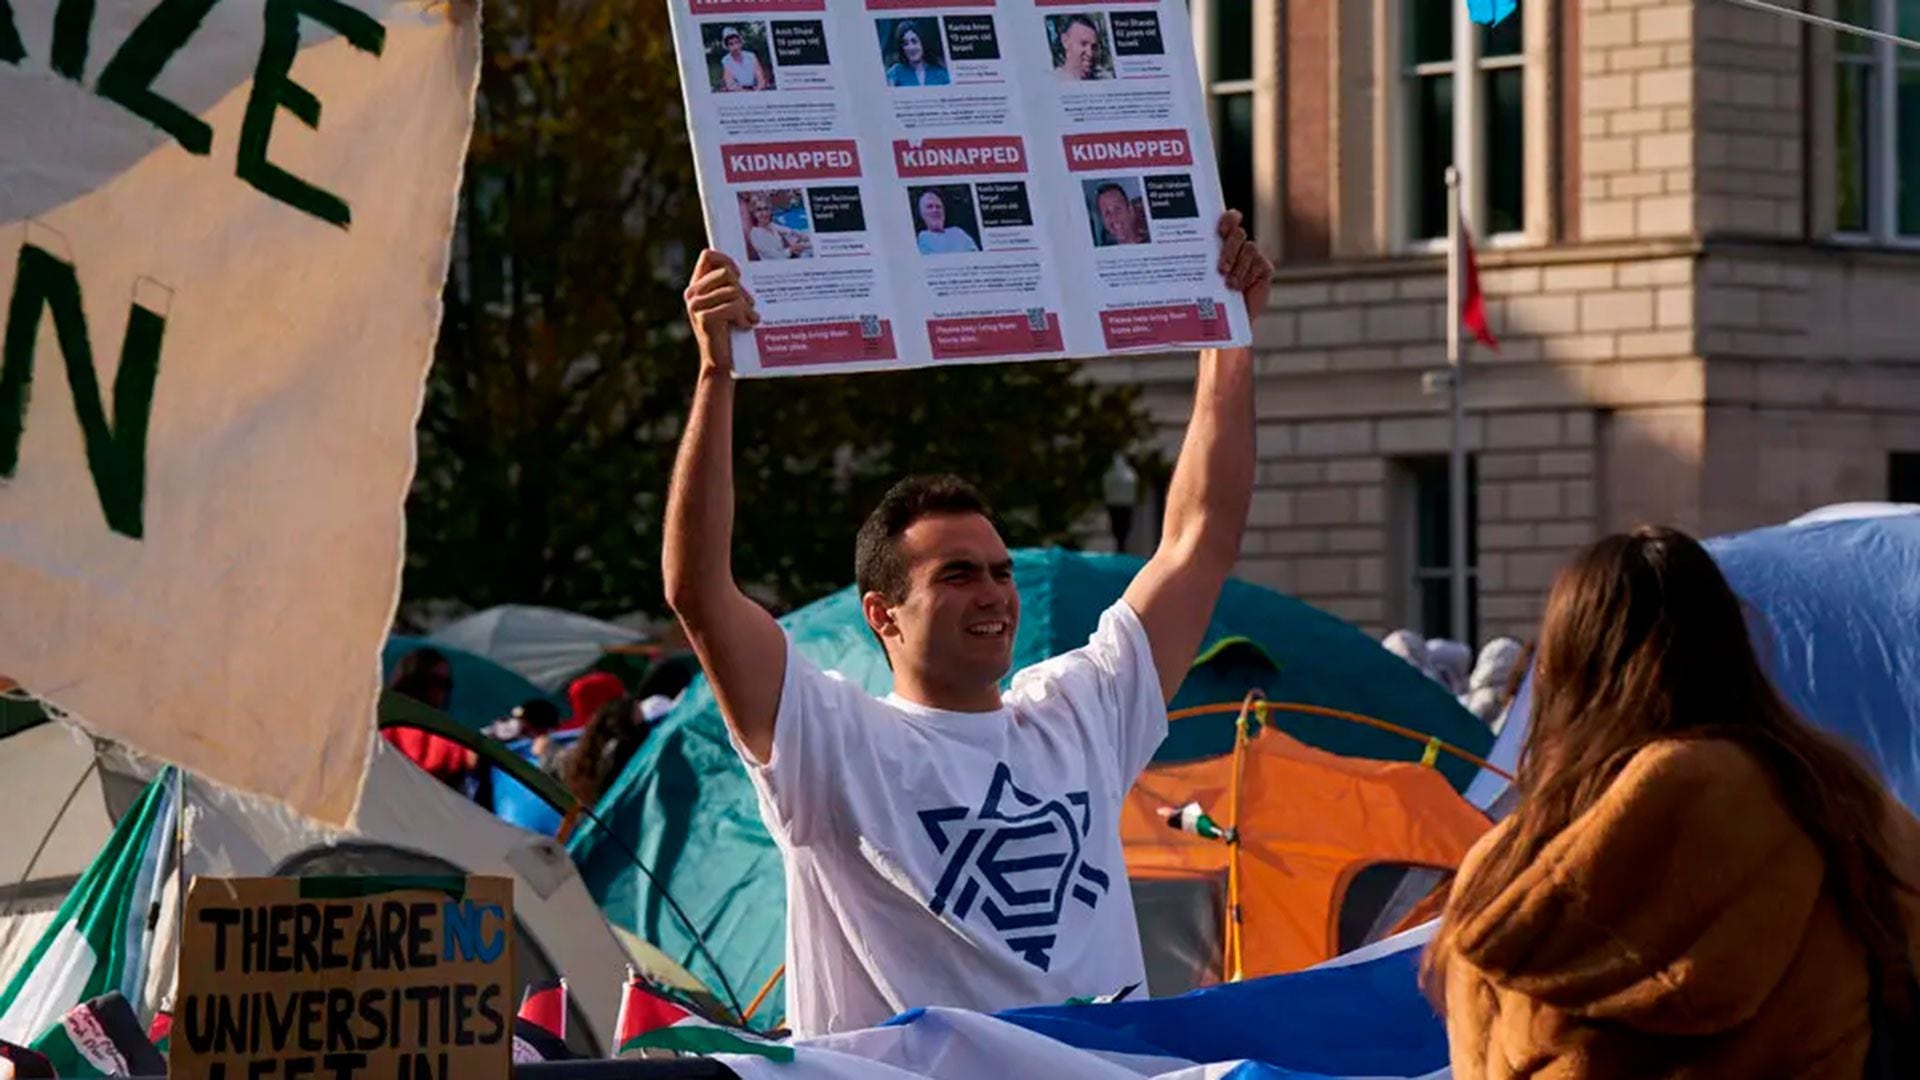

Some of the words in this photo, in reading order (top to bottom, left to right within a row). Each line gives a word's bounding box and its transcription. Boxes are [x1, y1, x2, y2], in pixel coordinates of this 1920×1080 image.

[901, 146, 1019, 167] KIDNAPPED
[1071, 140, 1184, 161] KIDNAPPED
[730, 150, 852, 173] KIDNAPPED
[1109, 315, 1131, 324] Please
[1150, 313, 1168, 323] bring
[764, 333, 789, 342] Please
[790, 332, 807, 342] help
[808, 330, 829, 340] bring
[936, 325, 960, 334] Please
[200, 904, 353, 974] THERE
[352, 902, 437, 971] ARE
[185, 984, 504, 1054] UNIVERSITIES
